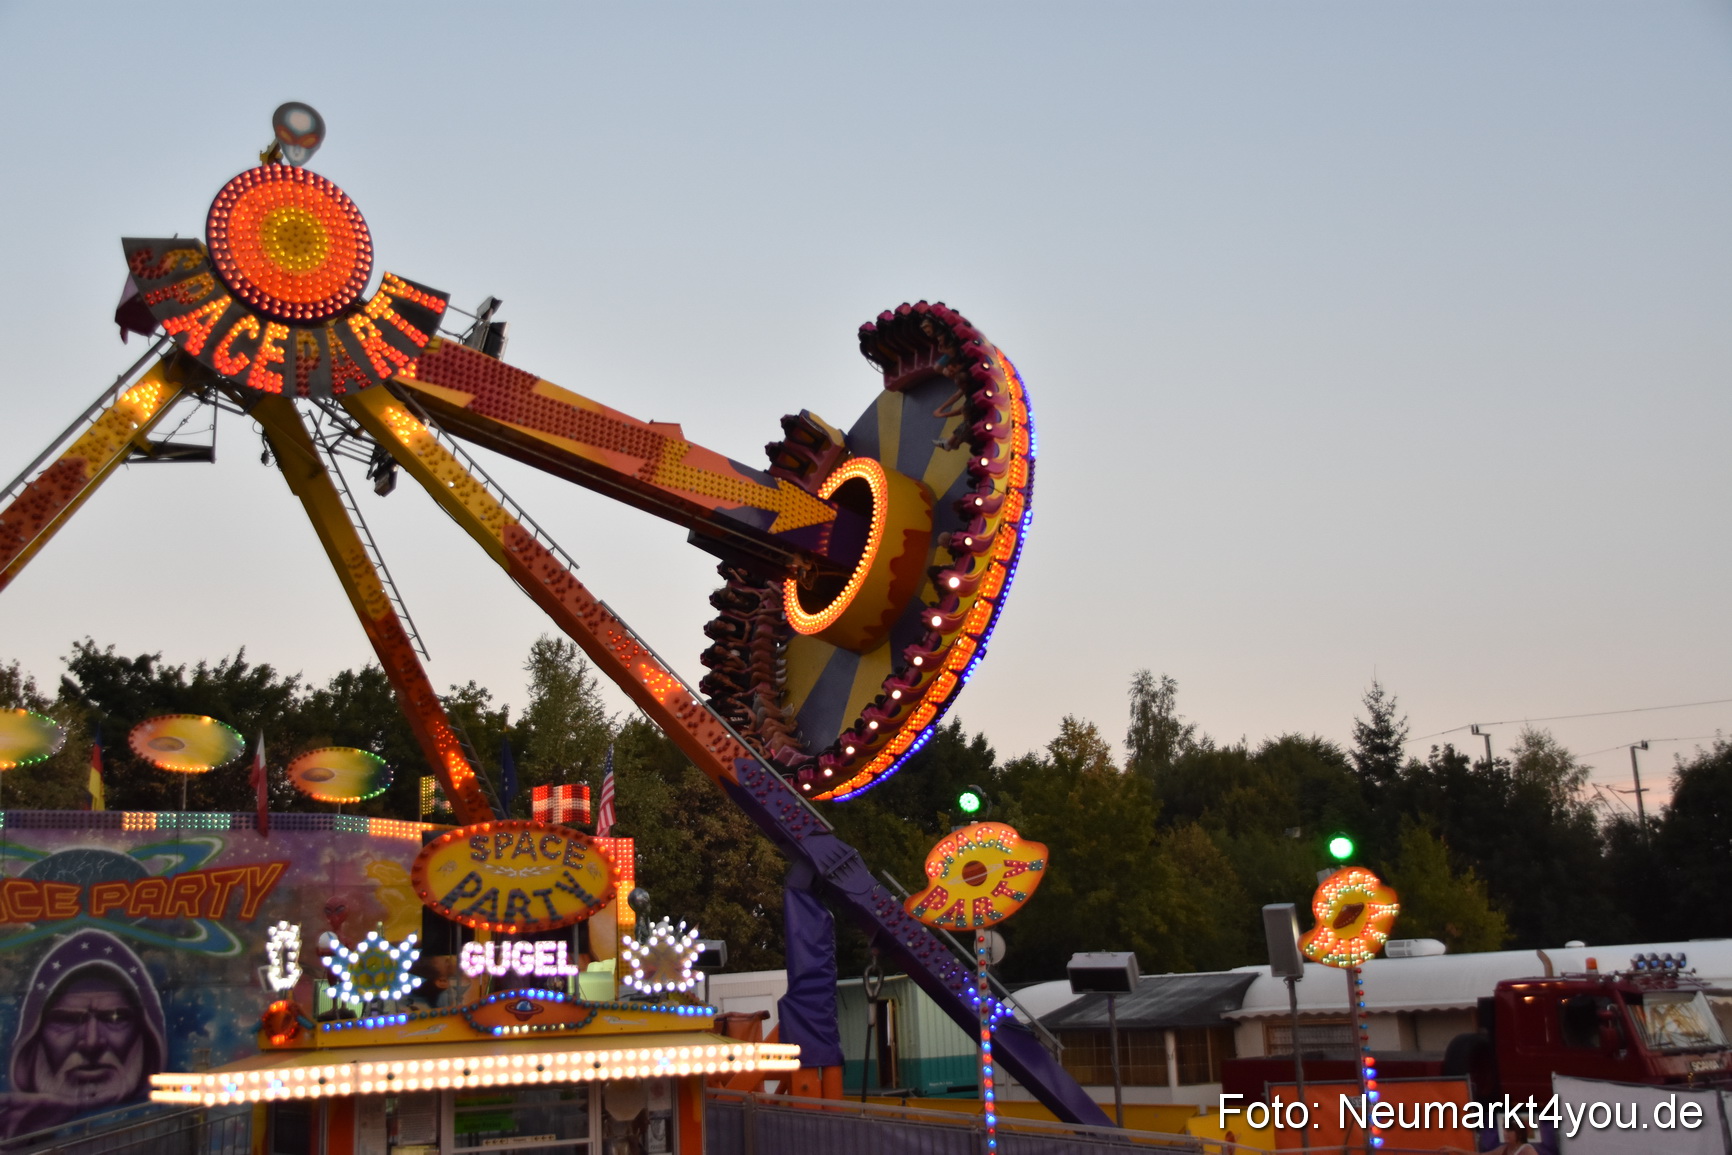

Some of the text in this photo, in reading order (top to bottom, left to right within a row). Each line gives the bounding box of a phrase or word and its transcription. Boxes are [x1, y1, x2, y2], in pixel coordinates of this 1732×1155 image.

[295, 271, 447, 399] PARTY
[468, 830, 588, 870] SPACE
[926, 826, 1019, 879] SPACE
[88, 861, 291, 922] PARTY
[440, 870, 600, 924] PARTY
[911, 859, 1045, 927] PARTY
[460, 940, 579, 977] GUGEL
